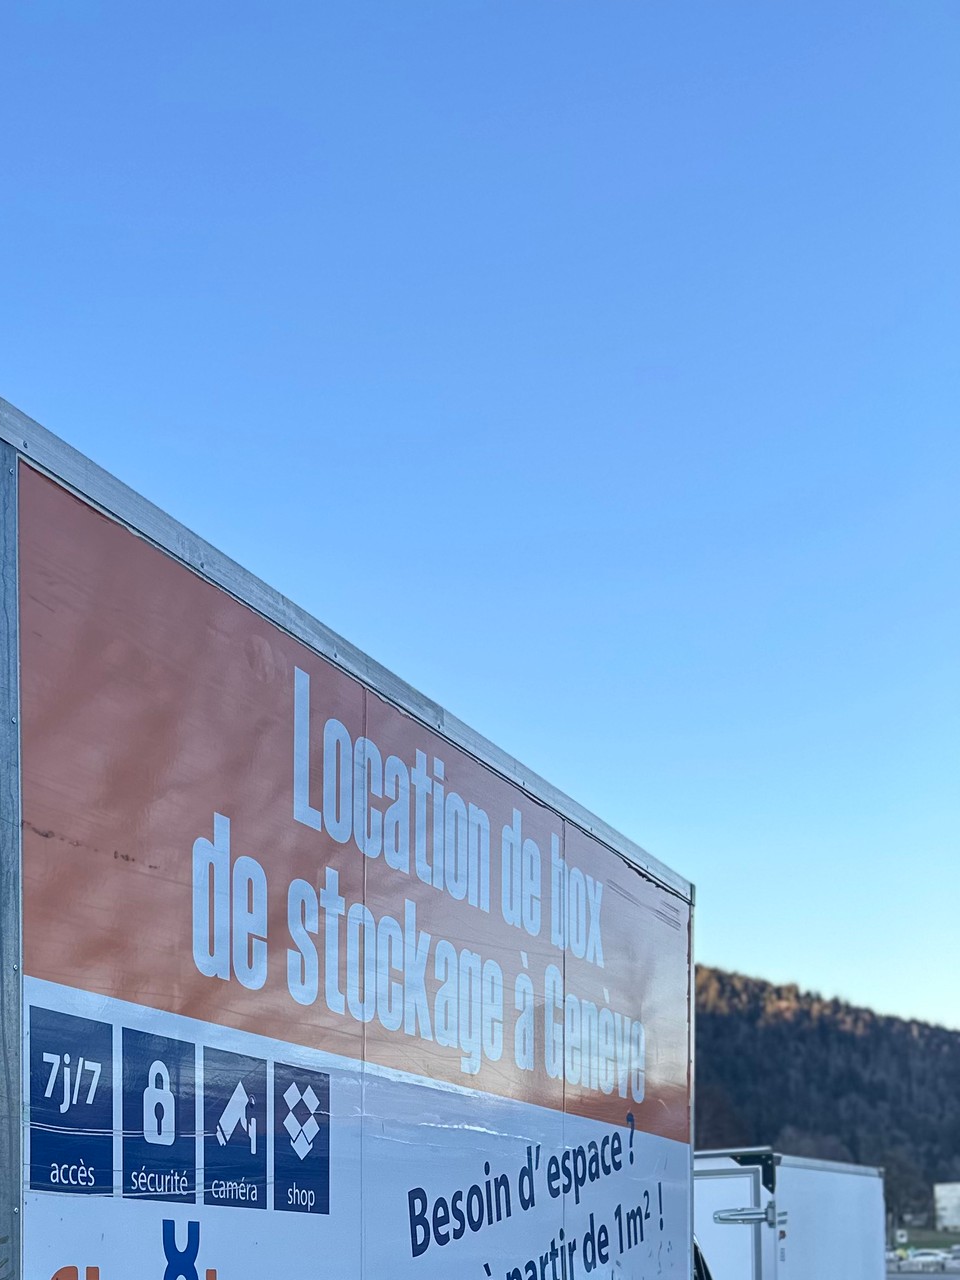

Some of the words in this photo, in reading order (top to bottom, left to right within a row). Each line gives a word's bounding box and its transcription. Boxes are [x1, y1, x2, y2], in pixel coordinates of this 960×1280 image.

[293, 666, 490, 914] Location
[501, 809, 541, 940] de
[552, 833, 604, 969] box
[192, 812, 268, 990] de
[287, 867, 503, 1076] stockage
[514, 951, 535, 1073] à
[545, 964, 646, 1104] Genève
[42, 1052, 102, 1114] 7j/7
[50, 1159, 95, 1187] accès
[131, 1166, 188, 1195] sécurité
[211, 1177, 258, 1202] caméra
[287, 1182, 315, 1211] shop
[407, 1161, 512, 1257] Besoin
[583, 1213, 609, 1273] de
